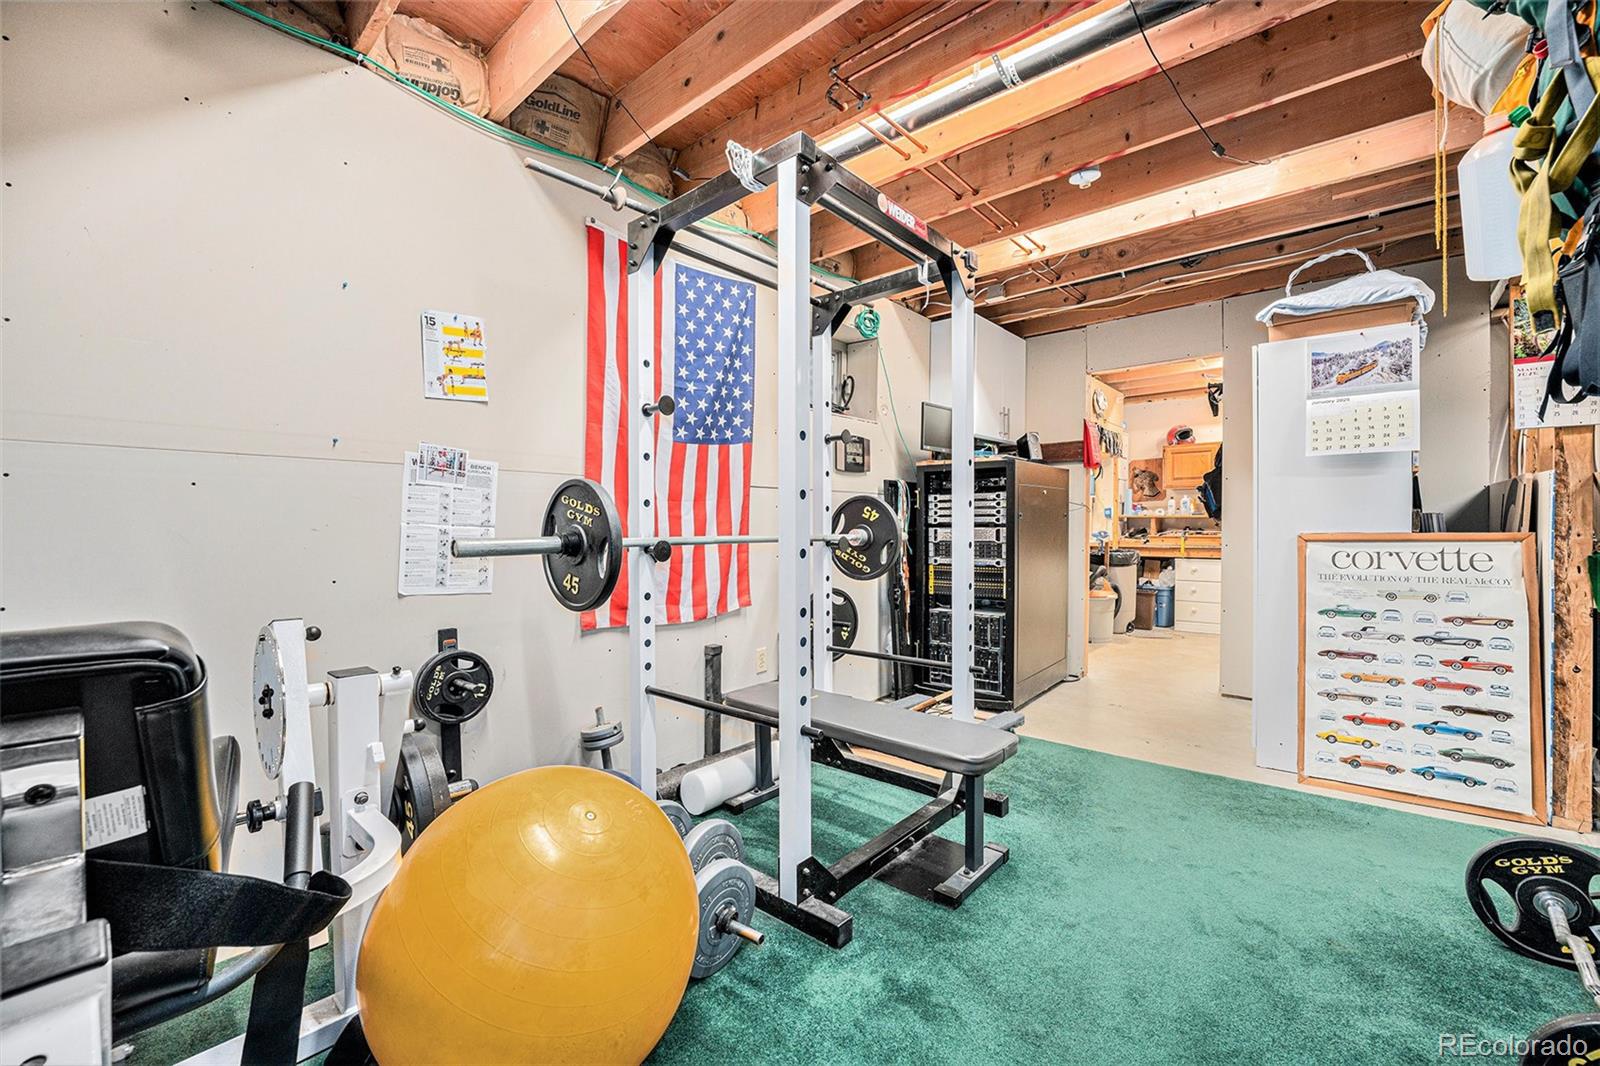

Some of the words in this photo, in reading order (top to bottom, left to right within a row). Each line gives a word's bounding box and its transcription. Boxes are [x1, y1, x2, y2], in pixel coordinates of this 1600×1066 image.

[887, 200, 916, 230] WEIDER
[424, 316, 436, 326] 15
[567, 509, 593, 528] GYM
[862, 505, 880, 522] 45
[1331, 547, 1494, 573] corvette
[562, 573, 579, 595] 45
[1317, 573, 1338, 581] THE
[1340, 574, 1399, 583] EVOLUTION
[1399, 575, 1412, 583] OF
[1416, 576, 1439, 584] THE
[1442, 577, 1472, 585] REAL
[1474, 577, 1512, 586] McCOY
[404, 800, 415, 840] 45
[1494, 854, 1574, 867] GOLD'S
[1511, 865, 1566, 875] GYM
